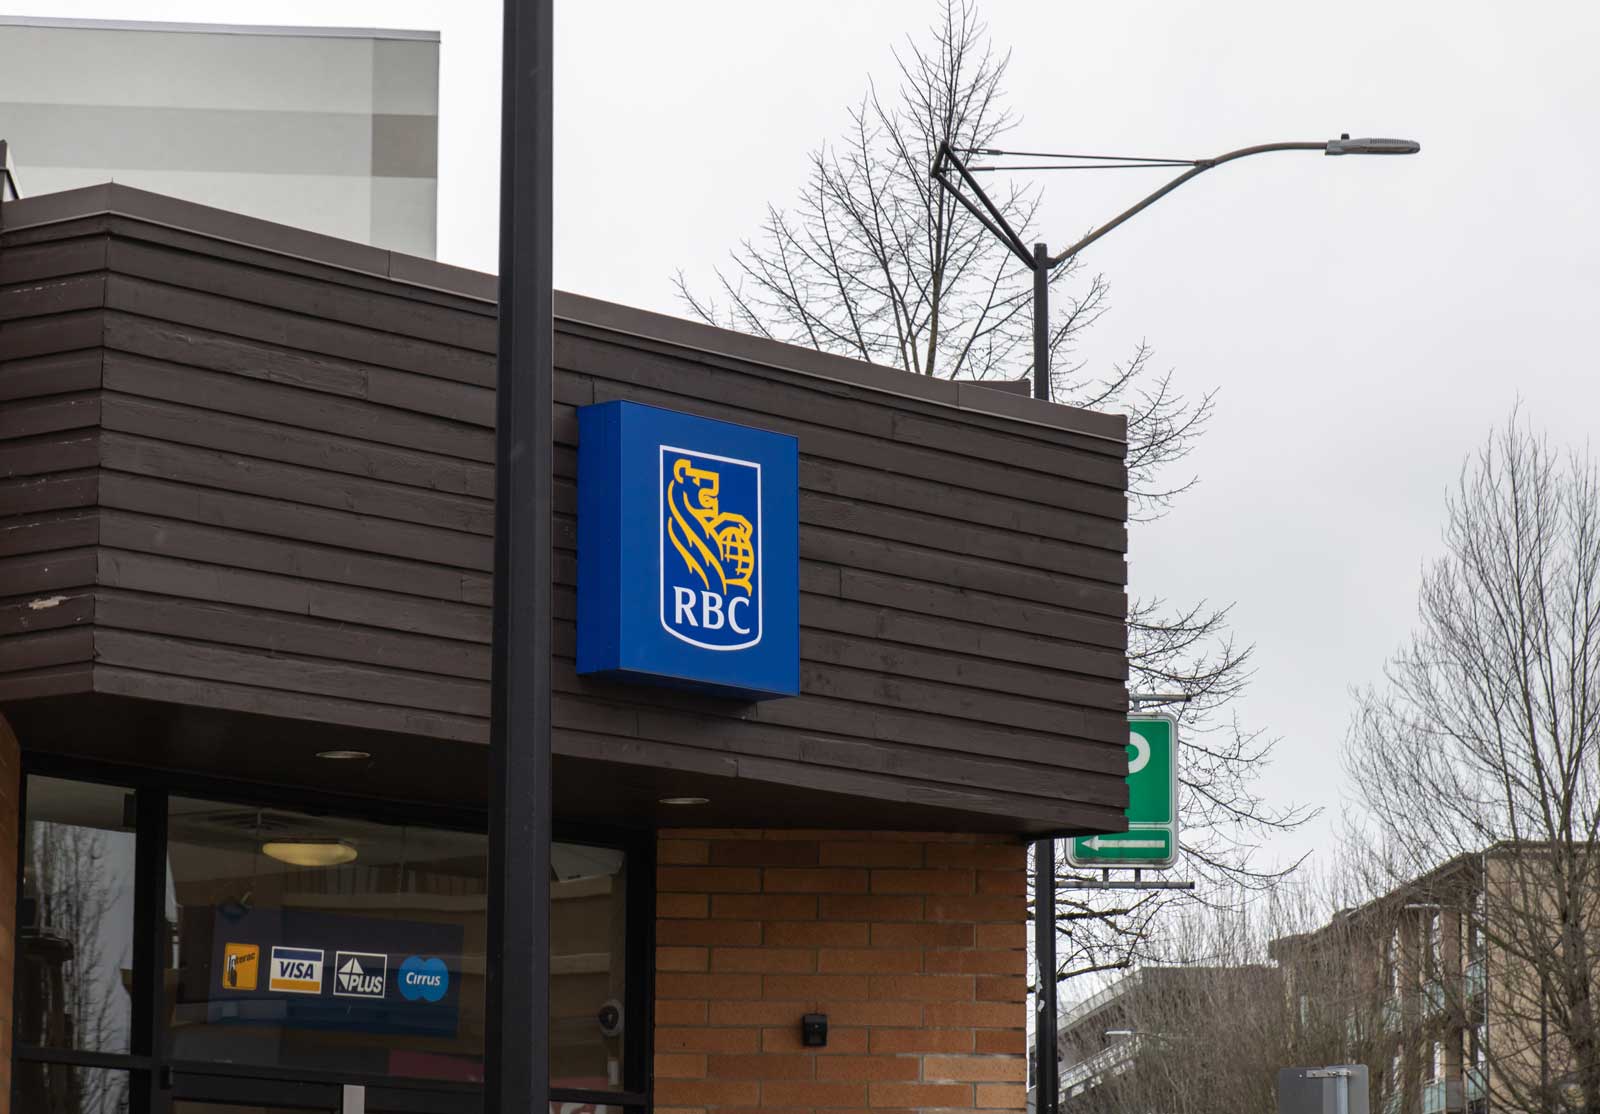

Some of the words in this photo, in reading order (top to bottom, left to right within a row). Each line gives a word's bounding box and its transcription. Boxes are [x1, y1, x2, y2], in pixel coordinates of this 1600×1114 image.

[672, 585, 751, 635] RBC
[280, 960, 314, 979] VISA
[405, 972, 441, 986] Cirrus
[348, 974, 383, 993] PLUS
